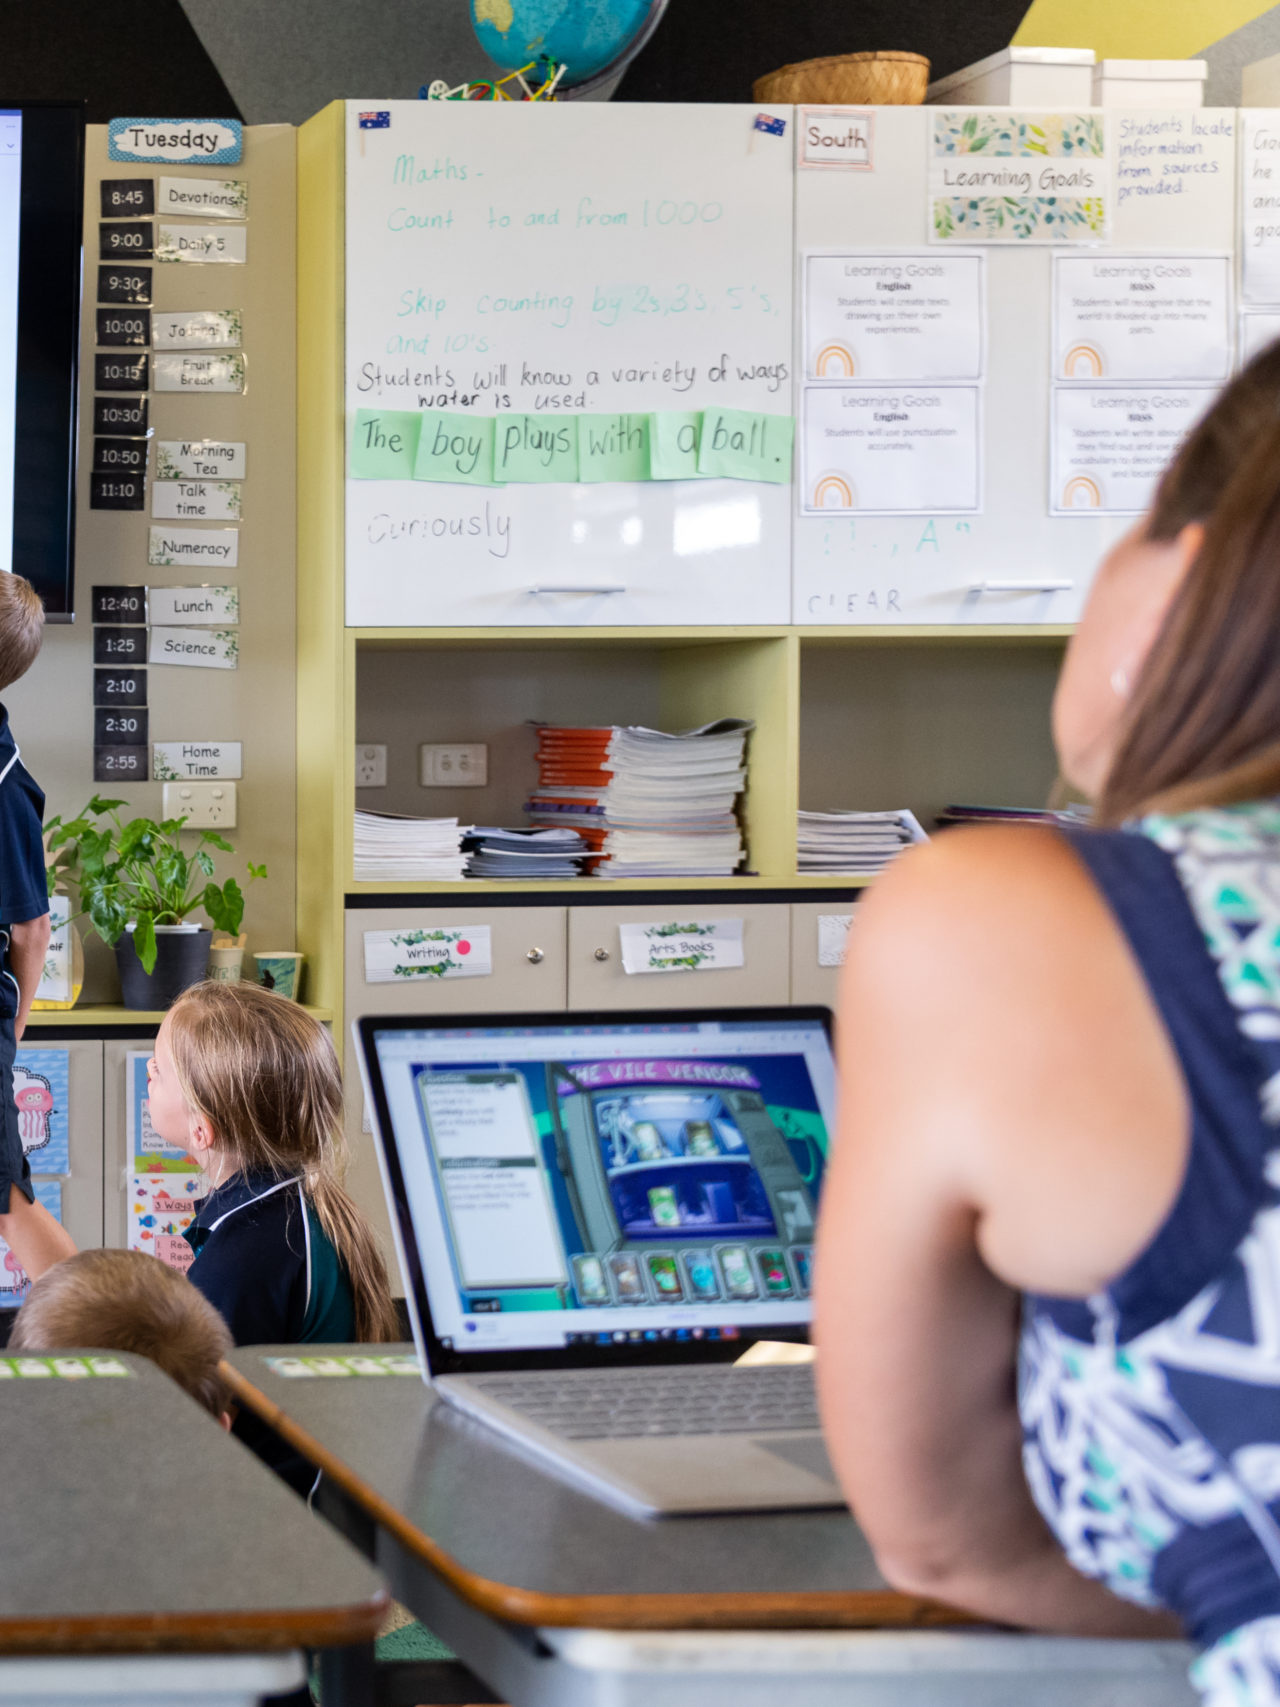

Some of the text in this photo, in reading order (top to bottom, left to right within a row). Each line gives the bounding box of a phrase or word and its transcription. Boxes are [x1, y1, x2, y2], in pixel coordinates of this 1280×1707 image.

[129, 128, 219, 153] Tuesday
[808, 126, 867, 150] South
[943, 167, 1094, 193] Learning Goals
[112, 191, 144, 205] 8:45
[169, 189, 236, 206] Devotions
[387, 197, 723, 232] Count to and from 1000
[111, 234, 143, 247] 9:00
[179, 237, 225, 253] Daily 5
[109, 277, 141, 291] 9:30
[105, 319, 144, 334] 10:00
[183, 359, 211, 371] Fruit
[104, 365, 141, 380] 10:15
[357, 354, 789, 393] Students will know a variety of ways
[181, 375, 214, 386] Break
[417, 390, 593, 408] water is used.
[102, 408, 141, 423] 10:30
[362, 417, 404, 454] The
[431, 419, 483, 475] boy
[502, 415, 572, 468] plays
[588, 415, 644, 457] with
[676, 424, 698, 455] a
[711, 415, 782, 464] ball.
[102, 450, 140, 465] 10:50
[180, 444, 235, 461] Morning
[193, 463, 218, 475] Tea
[101, 483, 135, 497] 11:10
[177, 484, 206, 497] Talk
[176, 502, 206, 515] time
[162, 540, 231, 559] Numeracy
[100, 598, 138, 611] 12:40
[173, 600, 214, 613] Lunch
[106, 639, 136, 653] 1:25
[164, 640, 217, 656] Science
[106, 680, 136, 693] 2:10
[106, 719, 137, 732] 2:30
[182, 745, 221, 758] Home
[106, 756, 137, 769] 2:55
[185, 763, 218, 775] Time
[406, 944, 450, 960] Writing
[649, 941, 714, 955] Arts Books
[165, 1201, 192, 1211] Ways
